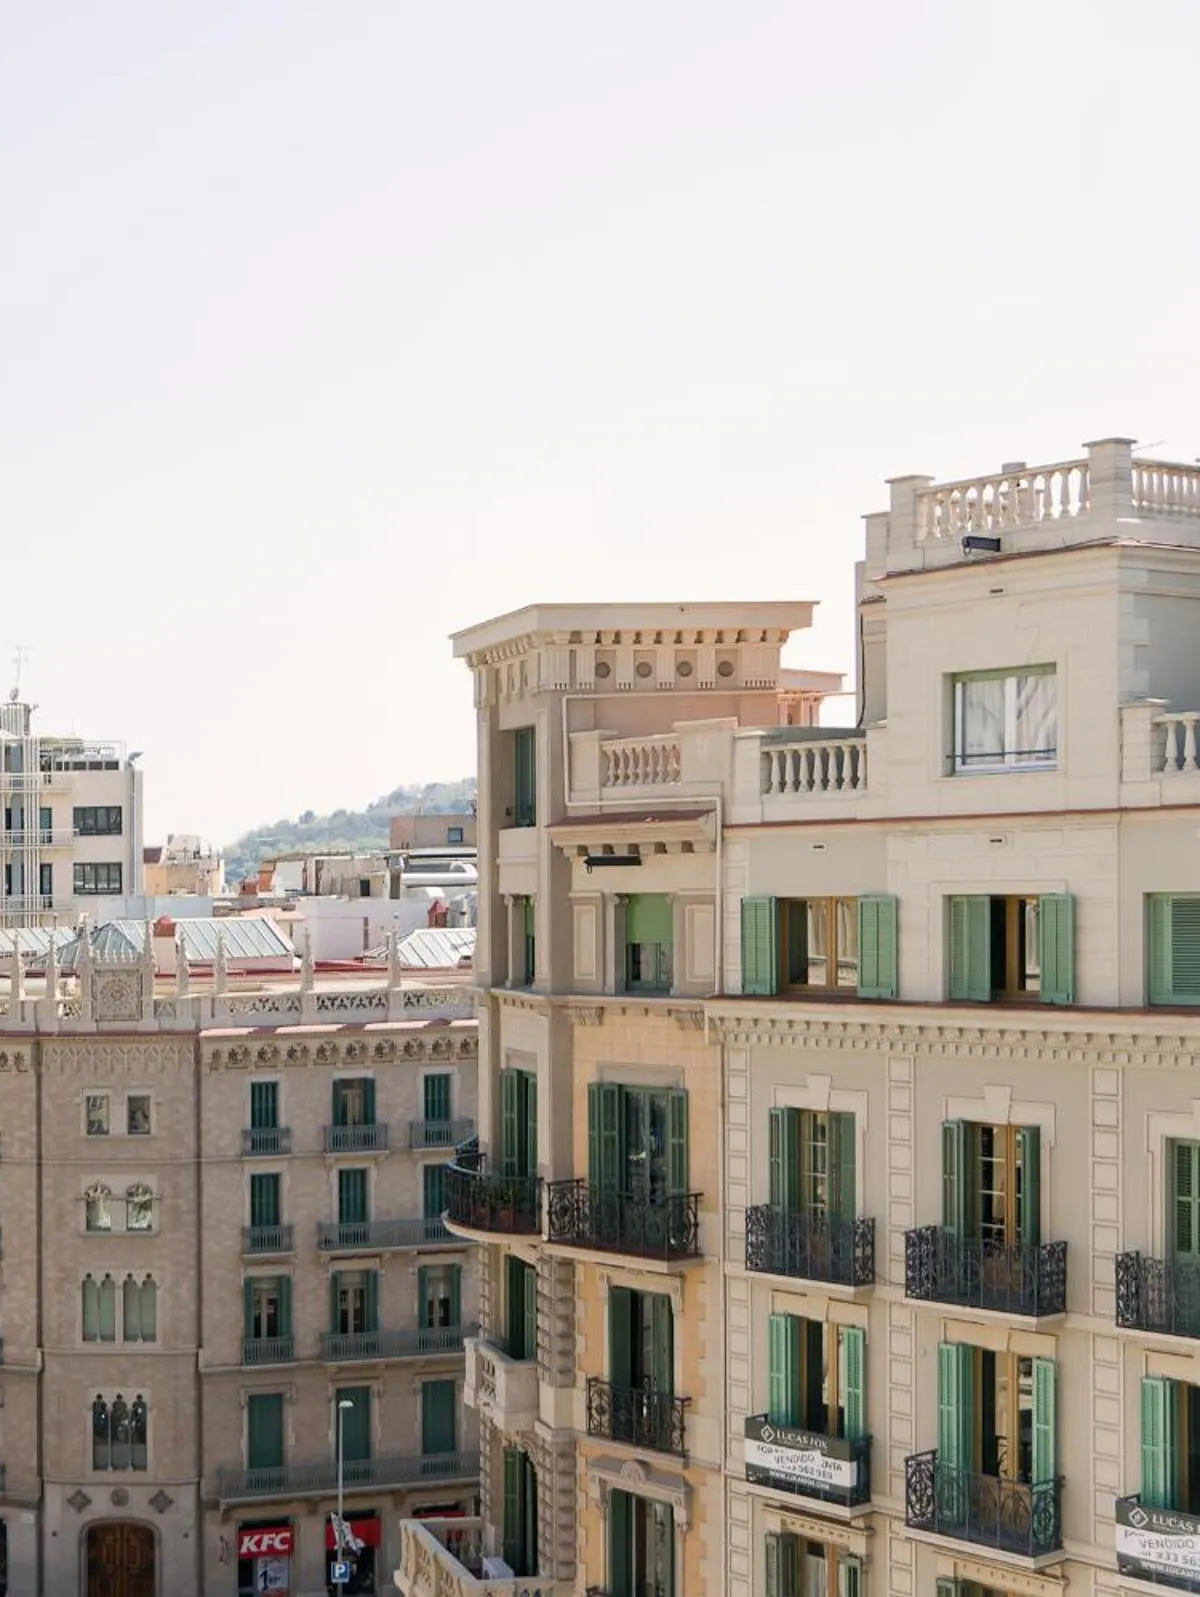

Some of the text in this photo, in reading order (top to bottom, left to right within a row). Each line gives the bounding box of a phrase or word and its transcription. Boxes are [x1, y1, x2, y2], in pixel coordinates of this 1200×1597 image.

[1152, 1514, 1194, 1532] LUCAS
[240, 1532, 291, 1554] KFC
[335, 1564, 346, 1578] P
